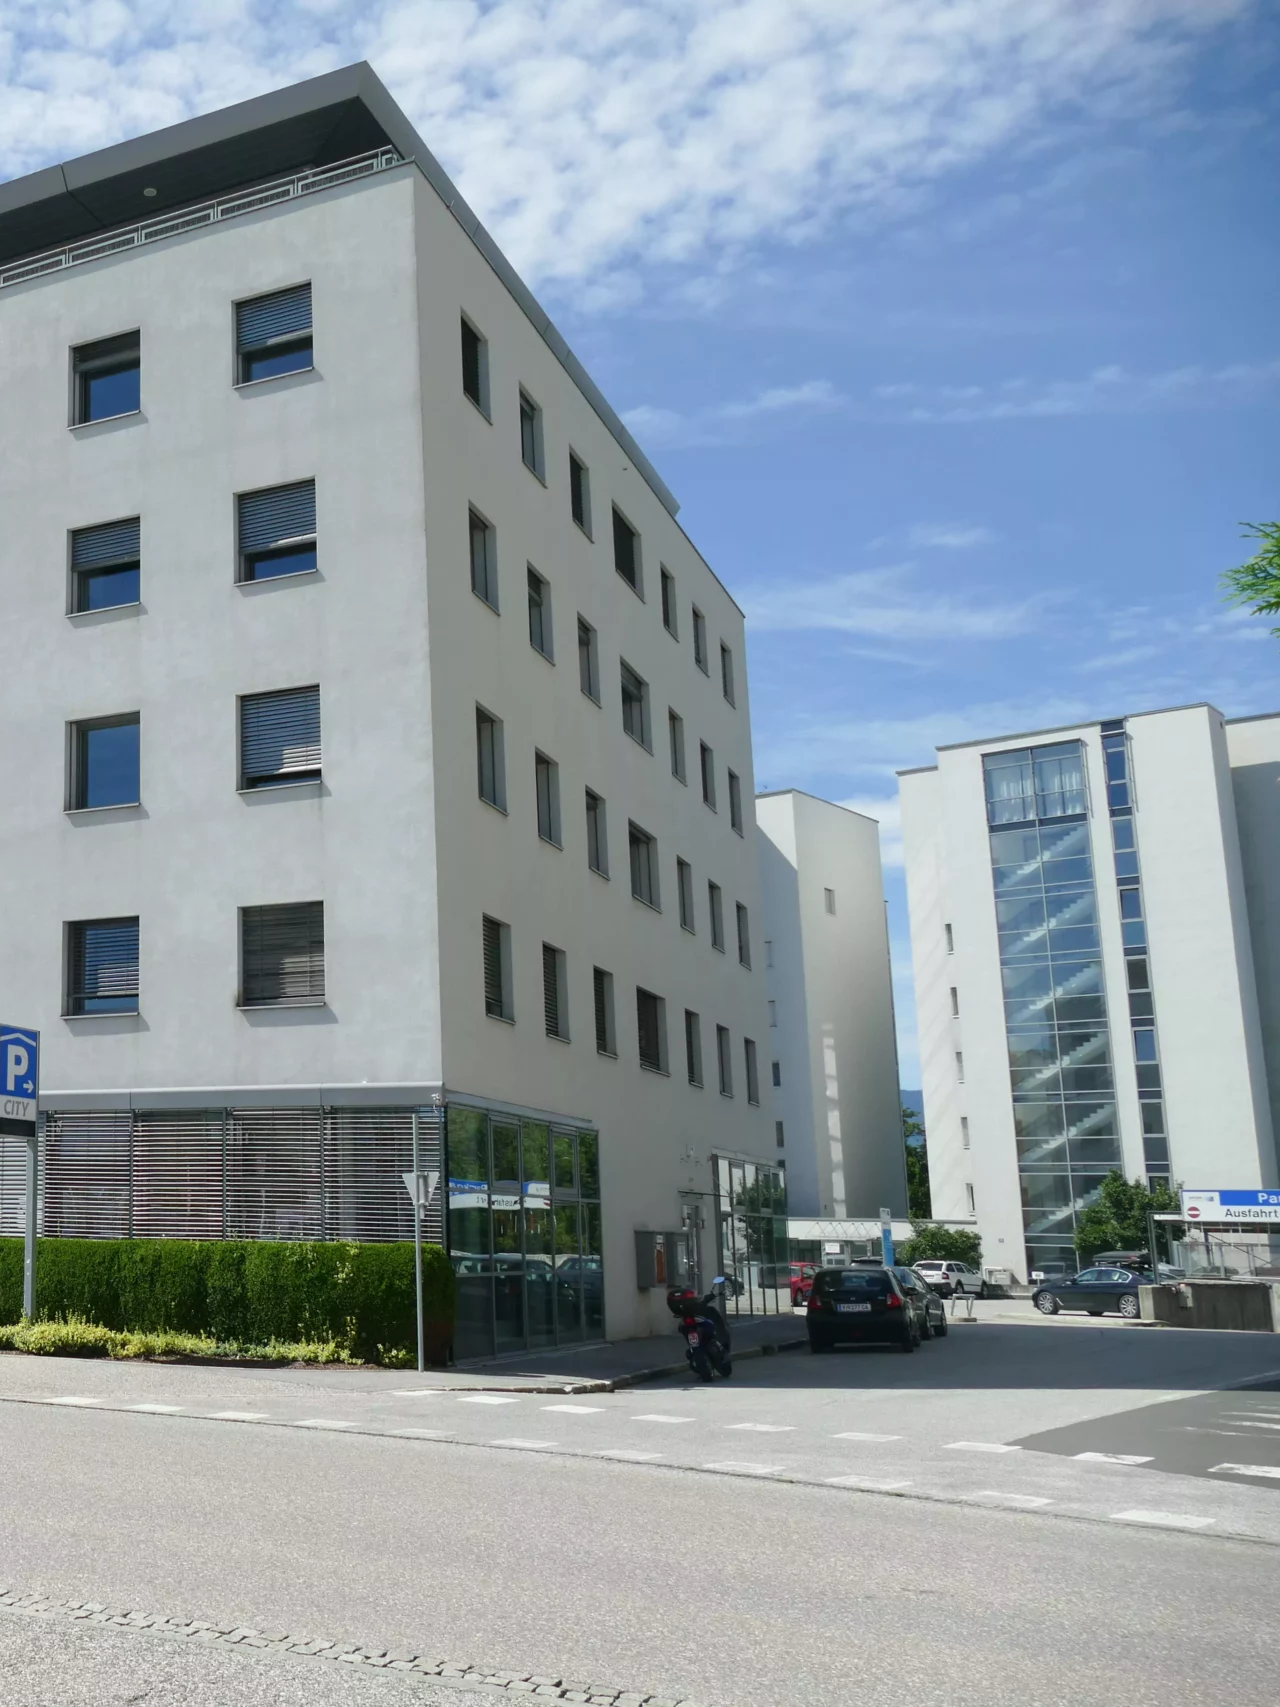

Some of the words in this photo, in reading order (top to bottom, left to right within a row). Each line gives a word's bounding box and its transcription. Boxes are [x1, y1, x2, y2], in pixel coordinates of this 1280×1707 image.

[6, 1044, 29, 1091] P
[4, 1100, 30, 1116] CITY
[1224, 1208, 1279, 1218] Ausfahrt
